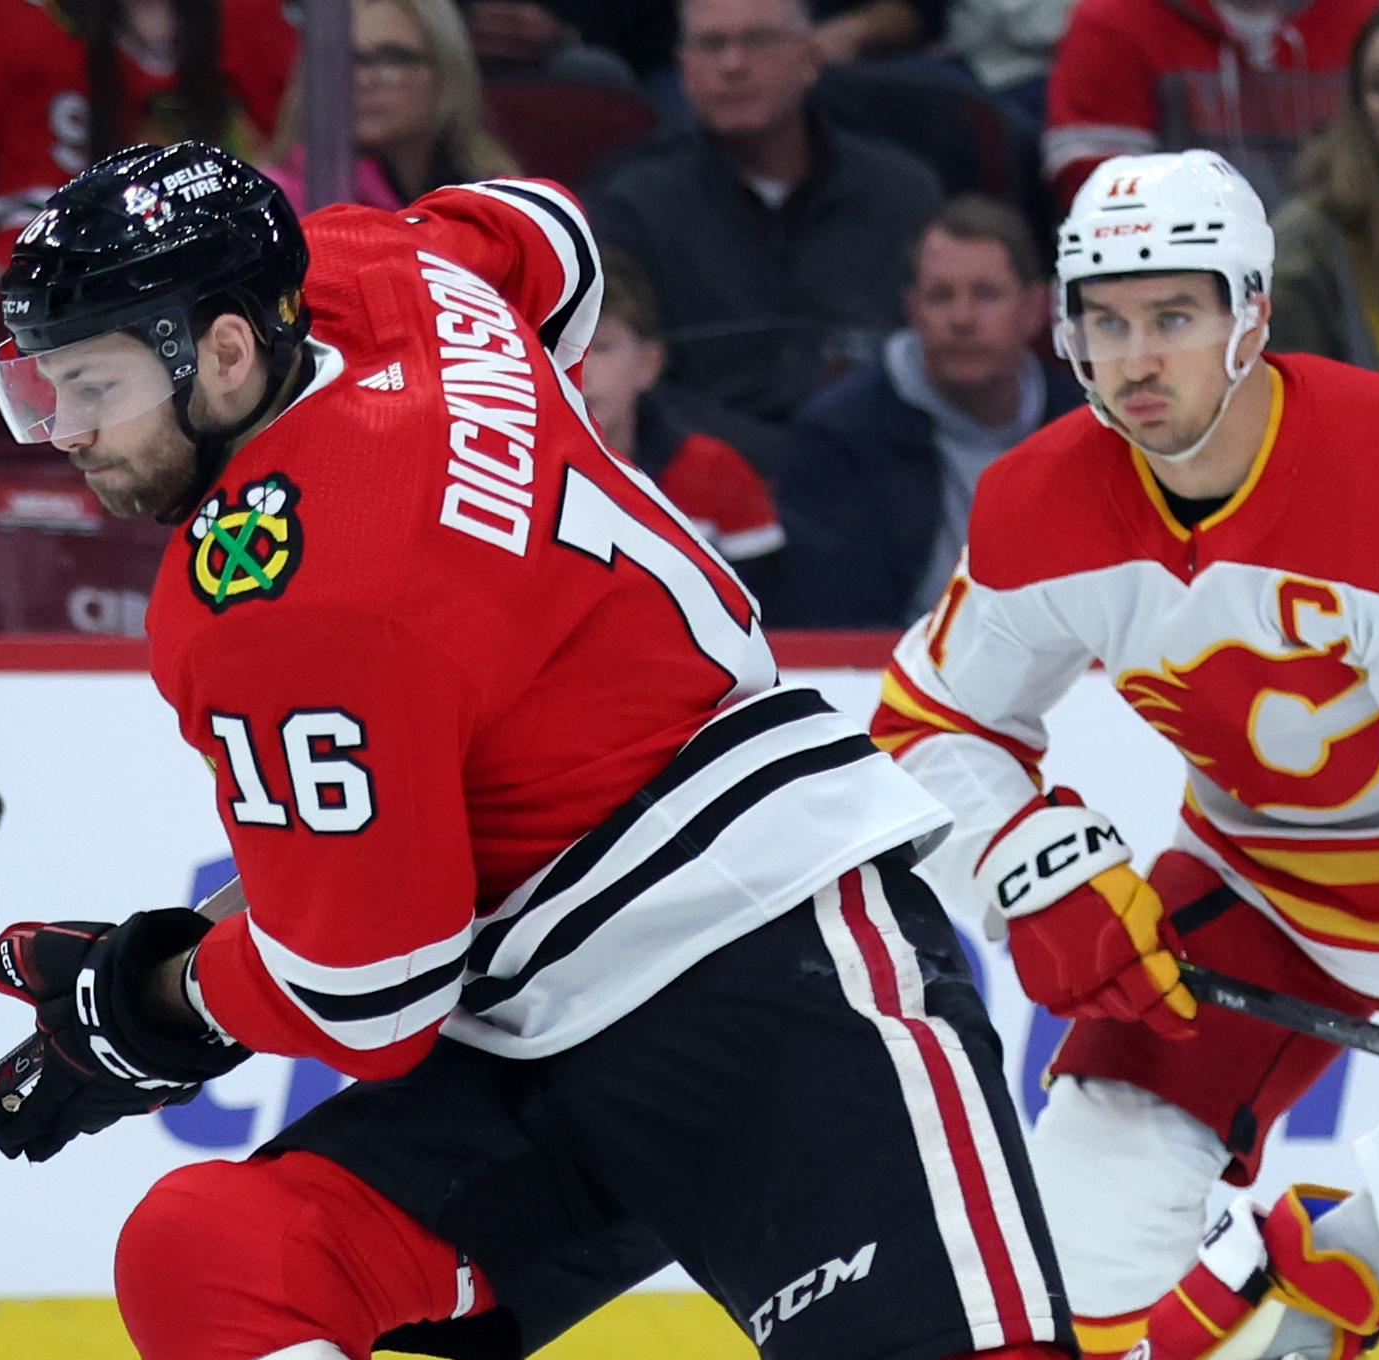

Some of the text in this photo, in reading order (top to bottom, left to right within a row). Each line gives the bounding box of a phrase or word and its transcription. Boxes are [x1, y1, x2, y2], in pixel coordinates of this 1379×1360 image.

[162, 160, 221, 192] BELLE
[178, 176, 222, 203] TIRE
[1107, 176, 1141, 197] 11
[16, 208, 61, 245] 16
[1094, 222, 1152, 239] CCM
[417, 250, 534, 557] DICKINSON
[1276, 577, 1348, 660] C
[210, 710, 376, 836] 16
[997, 825, 1125, 909] CCM
[0, 941, 24, 987] CCM
[749, 1241, 877, 1347] CCM
